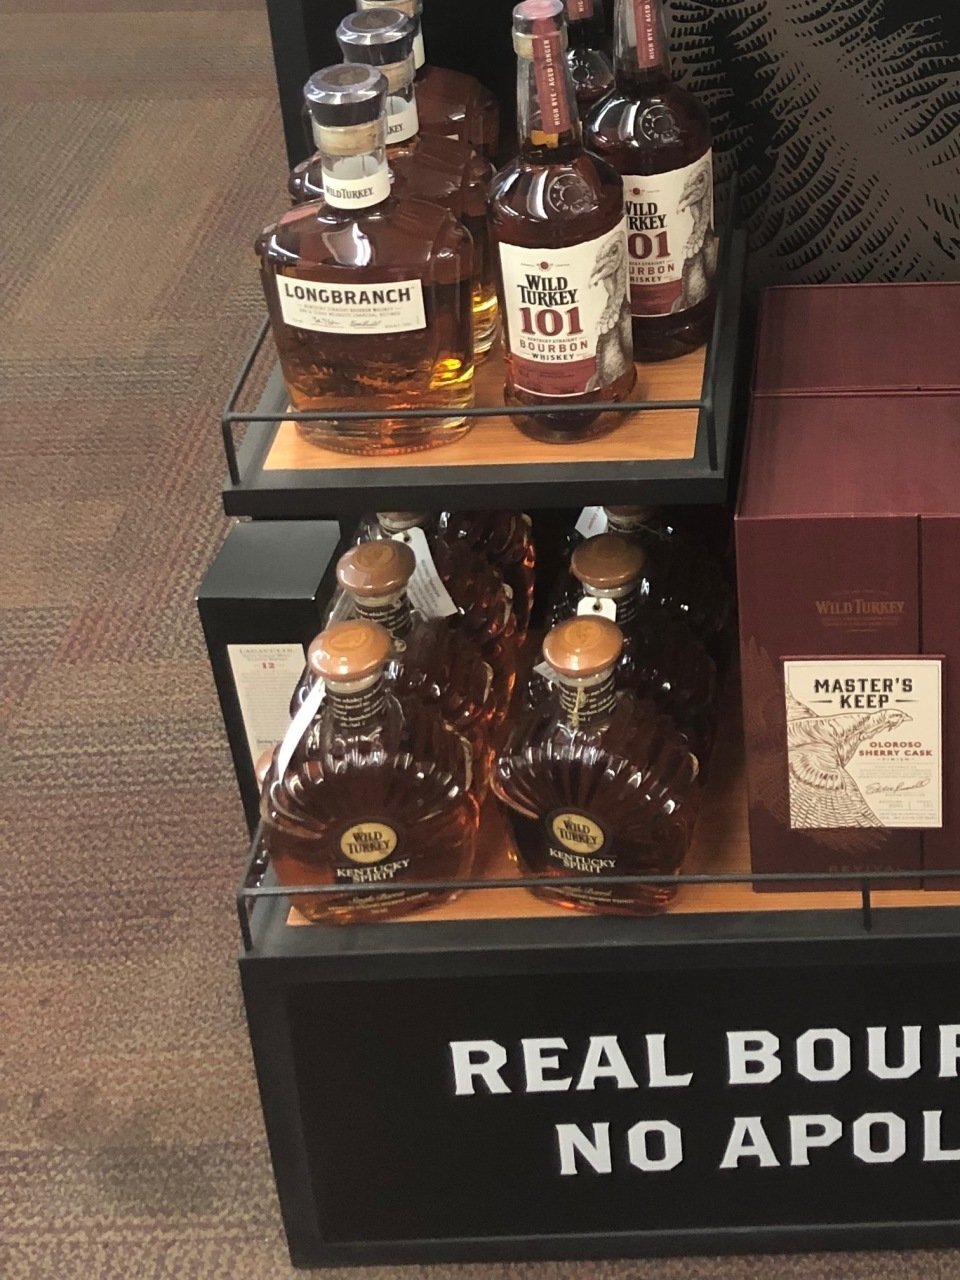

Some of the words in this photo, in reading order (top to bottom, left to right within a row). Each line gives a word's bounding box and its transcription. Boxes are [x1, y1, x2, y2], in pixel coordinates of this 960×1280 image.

[341, 187, 373, 200] TURKEY
[627, 214, 667, 231] RKEY
[628, 231, 671, 260] 01
[525, 274, 568, 291] WILD
[284, 283, 411, 305] LONGBRANCH
[517, 284, 579, 308] TURKEY
[519, 306, 583, 337] 101
[519, 339, 589, 353] BOURBON
[531, 353, 575, 361] WHISKEY
[815, 600, 853, 615] WILD
[855, 599, 905, 616] TURKEY
[814, 678, 913, 694] MASTER'S
[840, 694, 889, 709] KEEP
[859, 749, 900, 757] SHERRY
[904, 749, 933, 757] CASK
[549, 847, 616, 868] KENTUCKY
[336, 858, 410, 877] KENTUCKY
[449, 1033, 694, 1096] REAL
[556, 1120, 683, 1175] NO
